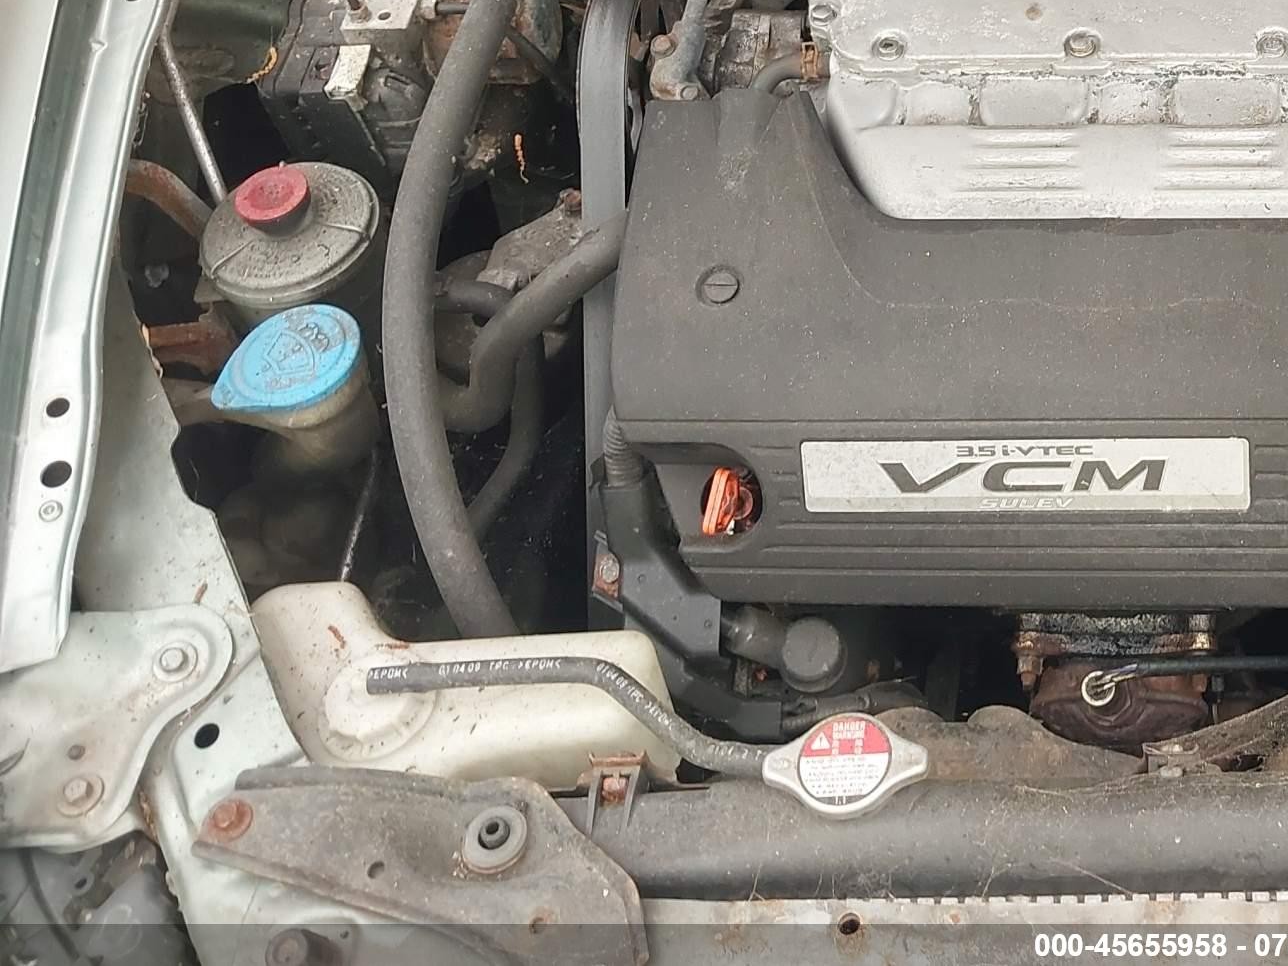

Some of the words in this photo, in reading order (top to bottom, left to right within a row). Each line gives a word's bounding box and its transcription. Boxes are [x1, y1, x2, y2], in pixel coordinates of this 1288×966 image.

[956, 445, 996, 457] 3.5
[877, 459, 1167, 494] VCM
[978, 496, 1073, 509] SULEV
